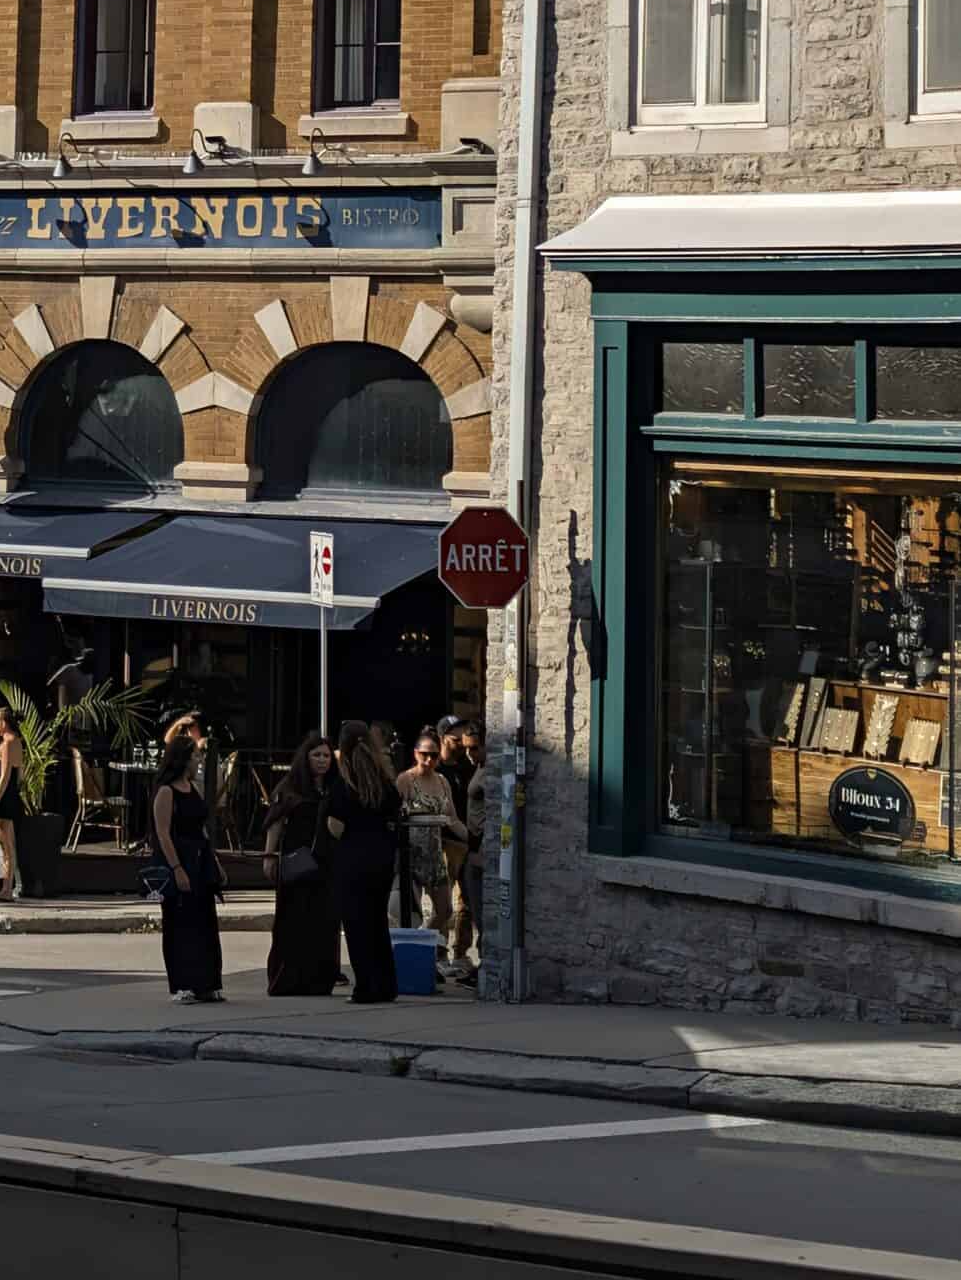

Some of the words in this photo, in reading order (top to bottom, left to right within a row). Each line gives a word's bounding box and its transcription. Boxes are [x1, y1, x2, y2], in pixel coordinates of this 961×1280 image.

[25, 197, 321, 240] LIVERNOIS
[342, 208, 421, 227] BISTRO
[445, 538, 527, 573] ARRÊT
[151, 597, 257, 623] LIVERNOIS
